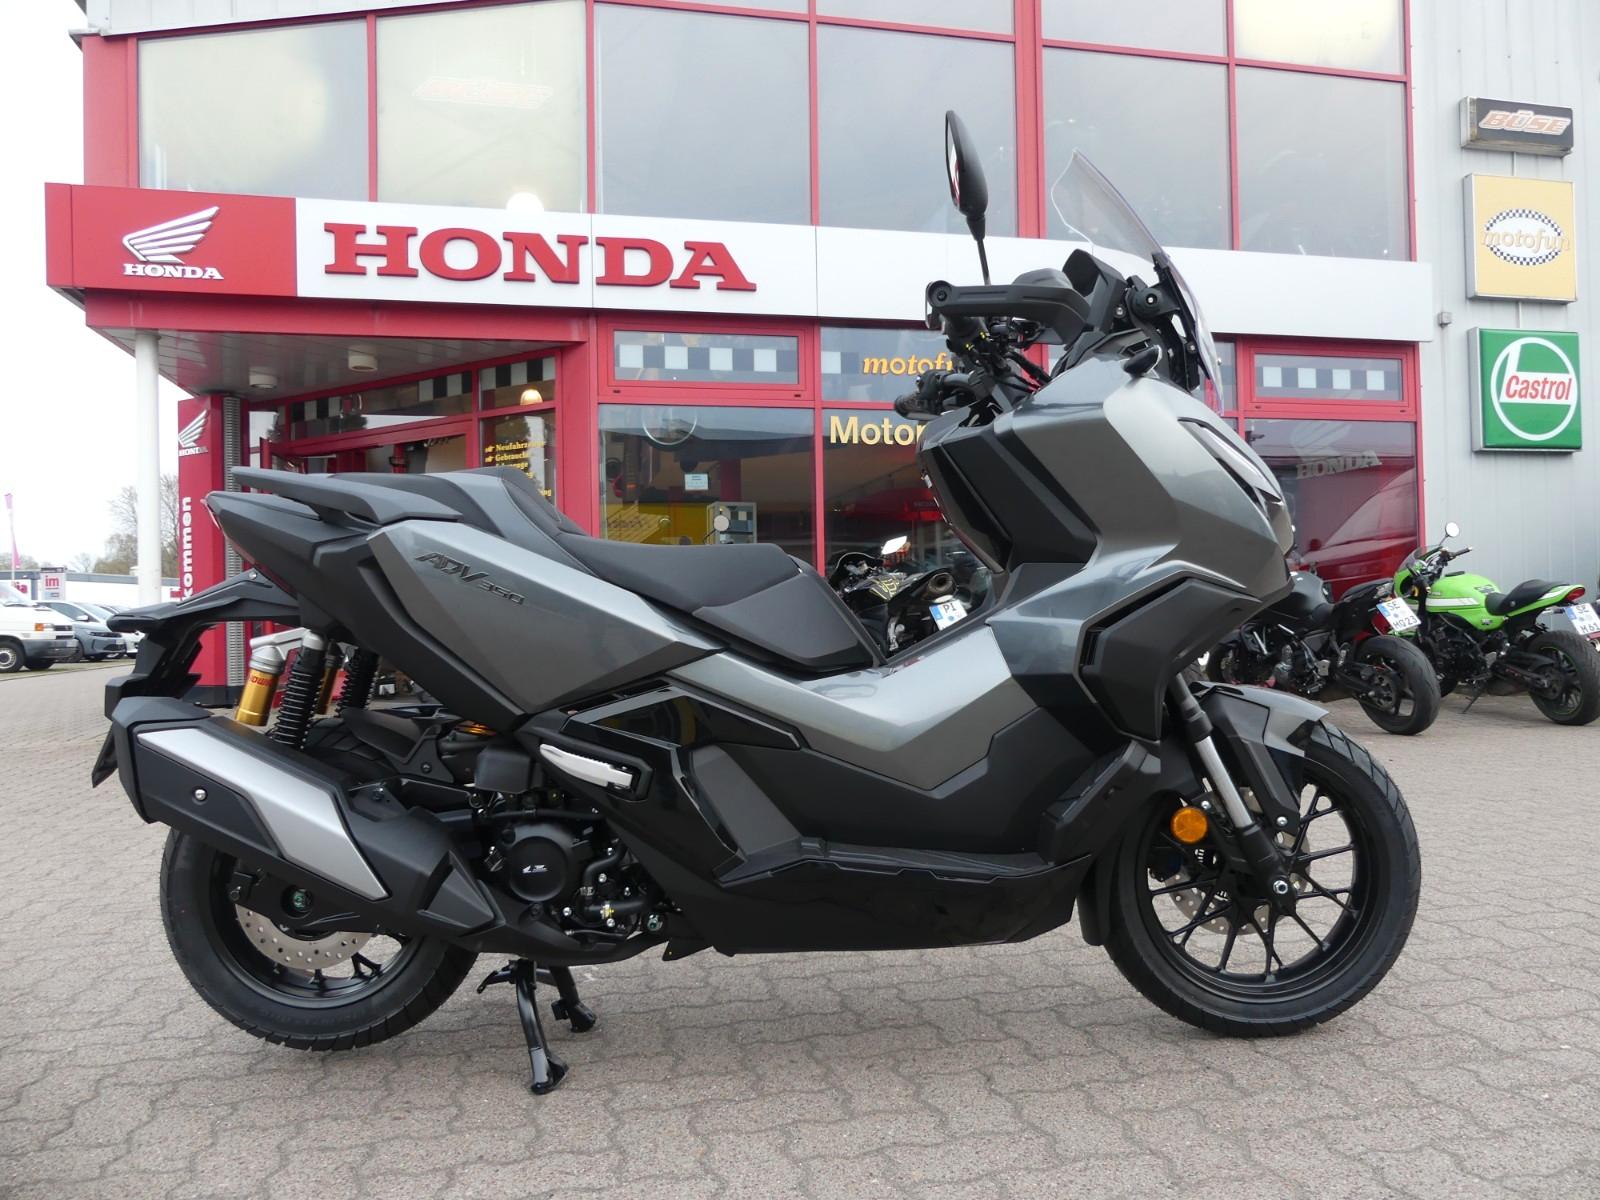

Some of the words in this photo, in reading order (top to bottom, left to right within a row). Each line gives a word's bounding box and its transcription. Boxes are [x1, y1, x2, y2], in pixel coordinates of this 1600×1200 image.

[1483, 228, 1570, 254] motofun
[324, 223, 757, 291] HONDA
[123, 263, 225, 280] HONDA
[1505, 375, 1572, 400] Castrol
[178, 446, 209, 457] HONDA
[1296, 450, 1382, 480] HONDA
